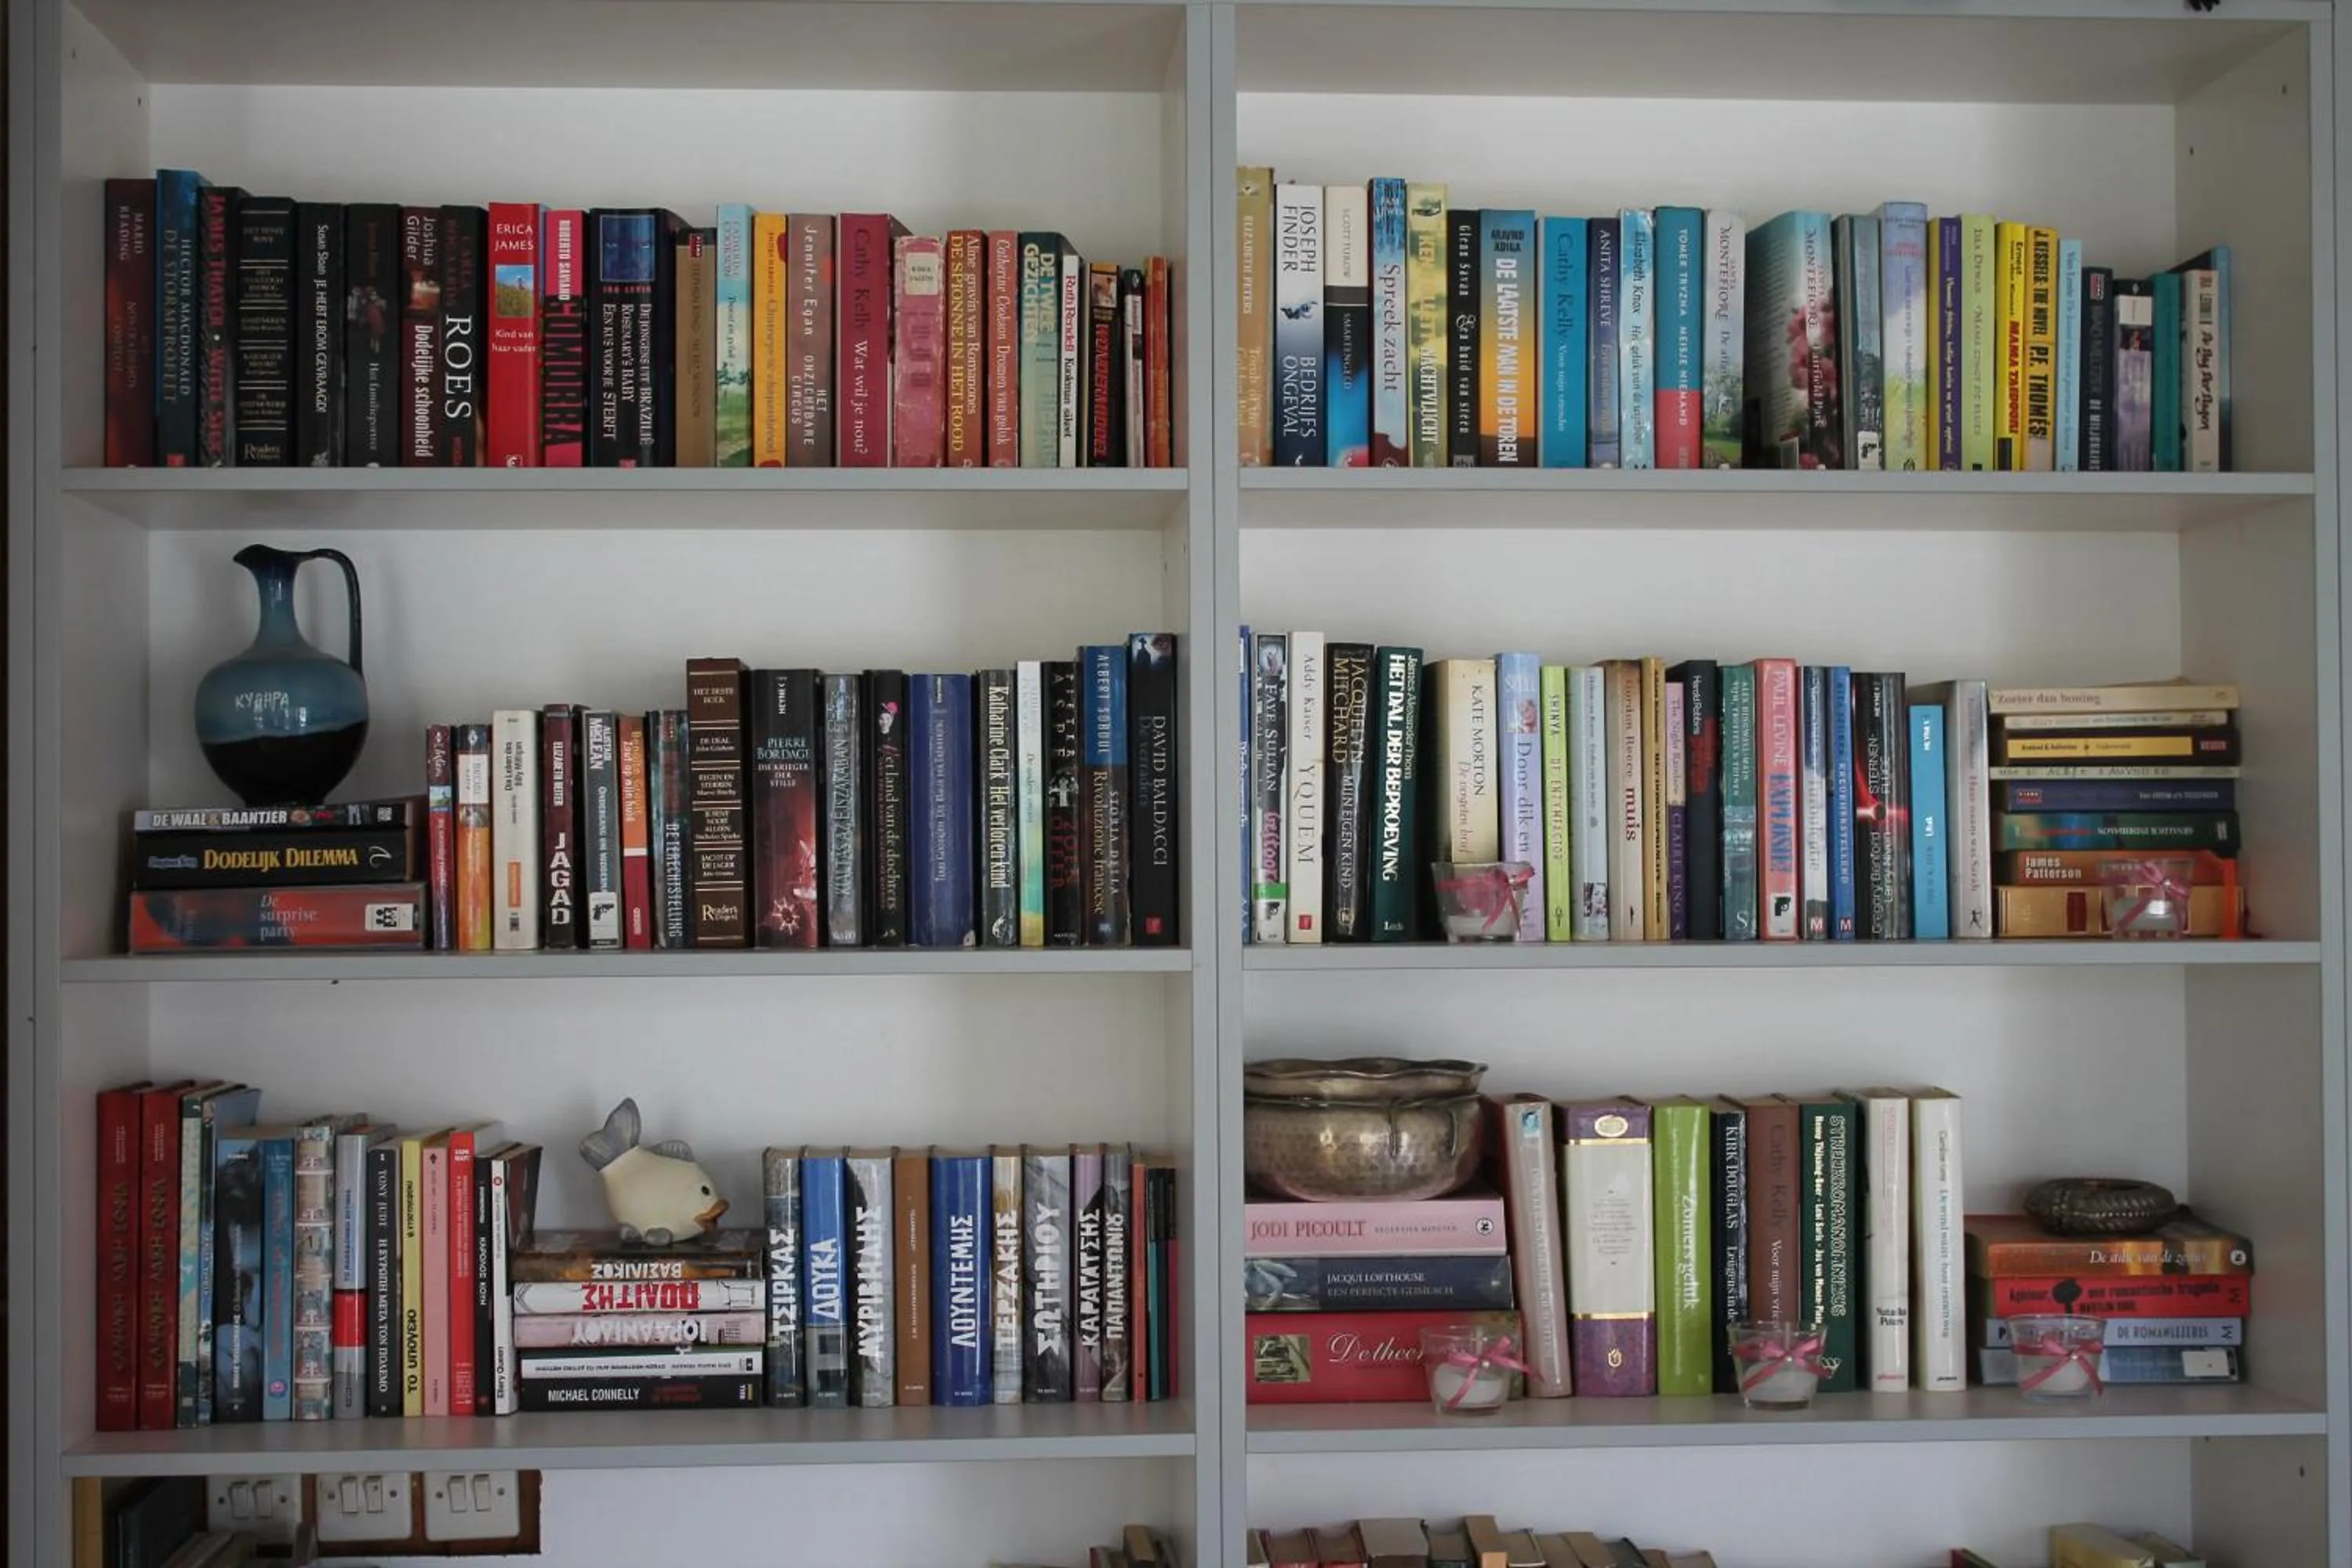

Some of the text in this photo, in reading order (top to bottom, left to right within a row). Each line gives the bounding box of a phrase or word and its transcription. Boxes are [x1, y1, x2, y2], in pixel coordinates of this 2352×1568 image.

[406, 215, 421, 260] Gilder
[422, 216, 437, 267] Joshua
[494, 238, 535, 251] JAMES
[495, 223, 534, 236] ERICA
[1283, 205, 1299, 272] FINDER
[1300, 205, 1317, 274] JOSEPH
[801, 225, 819, 336] Jennifer Egan
[1024, 244, 1040, 343] GEZICHTEN
[1040, 252, 1054, 332] DE TWEE
[1600, 228, 1612, 327] ANITA SHREVE
[445, 314, 473, 419] ROES
[495, 328, 517, 340] Kind
[853, 340, 868, 369] Wat
[951, 235, 964, 452] DE SPIONNE IN HET ROOD
[967, 315, 979, 339] van
[1377, 263, 1402, 393] Spreek zacht
[1496, 258, 1519, 463] DE LAATSTE MAN IN DE TOREN
[409, 325, 436, 458] Dodelijke schoonheid
[621, 368, 635, 403] BABY
[790, 376, 801, 425] CIRCUS
[816, 390, 829, 412] HET
[848, 400, 868, 416] je
[854, 376, 869, 397] wil
[1283, 355, 1300, 437] ONGEVAL
[1301, 356, 1317, 438] BEDRIJFS
[1420, 349, 1439, 445] NACHTVLUCHT
[1265, 684, 1279, 792] FAYE SULTAN
[1331, 658, 1350, 765] MITCHARD
[1348, 658, 1368, 765] JACQUELYN
[1471, 684, 1487, 797] KATE MORTON
[884, 772, 901, 802] land
[988, 685, 1011, 889] Katharine Clark Het verloren kind
[1152, 715, 1167, 866] DAVID BALDACCI
[1381, 654, 1406, 883] HET DAL DER BEPROEVING
[1515, 741, 1534, 853] Door dik en
[151, 813, 170, 828] DE
[171, 812, 207, 827] WAAL
[221, 809, 289, 826] BAANTJER
[884, 804, 898, 829] van
[884, 830, 901, 848] de
[1093, 771, 1110, 859] Rivoluzione
[1294, 764, 1317, 864] YQUEM
[203, 848, 283, 873] DODELIJK
[285, 848, 360, 868] DILEMMA
[883, 849, 902, 913] dochters
[2024, 856, 2061, 869] James
[2024, 867, 2082, 880] Patterson
[1725, 1125, 1740, 1163] KIRK
[1252, 1219, 1367, 1241] JODI PICOULT
[1725, 1165, 1740, 1230] DOUGLAS
[581, 1282, 701, 1311] ΠΟΛΙΤΗΣ
[769, 1229, 797, 1334] ΤΣΙΡΚΑΣ
[809, 1237, 840, 1320] ΔΟΥΚΑ
[949, 1214, 977, 1349] ΛΟΥΝΤΕΜΗΣ
[995, 1210, 1019, 1352] ΤΕΡΖΑΚΗΣ
[1033, 1201, 1062, 1357] ΣΩΤΗΡΙΟΥ
[1078, 1207, 1101, 1348] ΚΑΡΑΓΑΤΣΗΣ
[547, 1386, 641, 1402] MICHAEL CONNELLY
